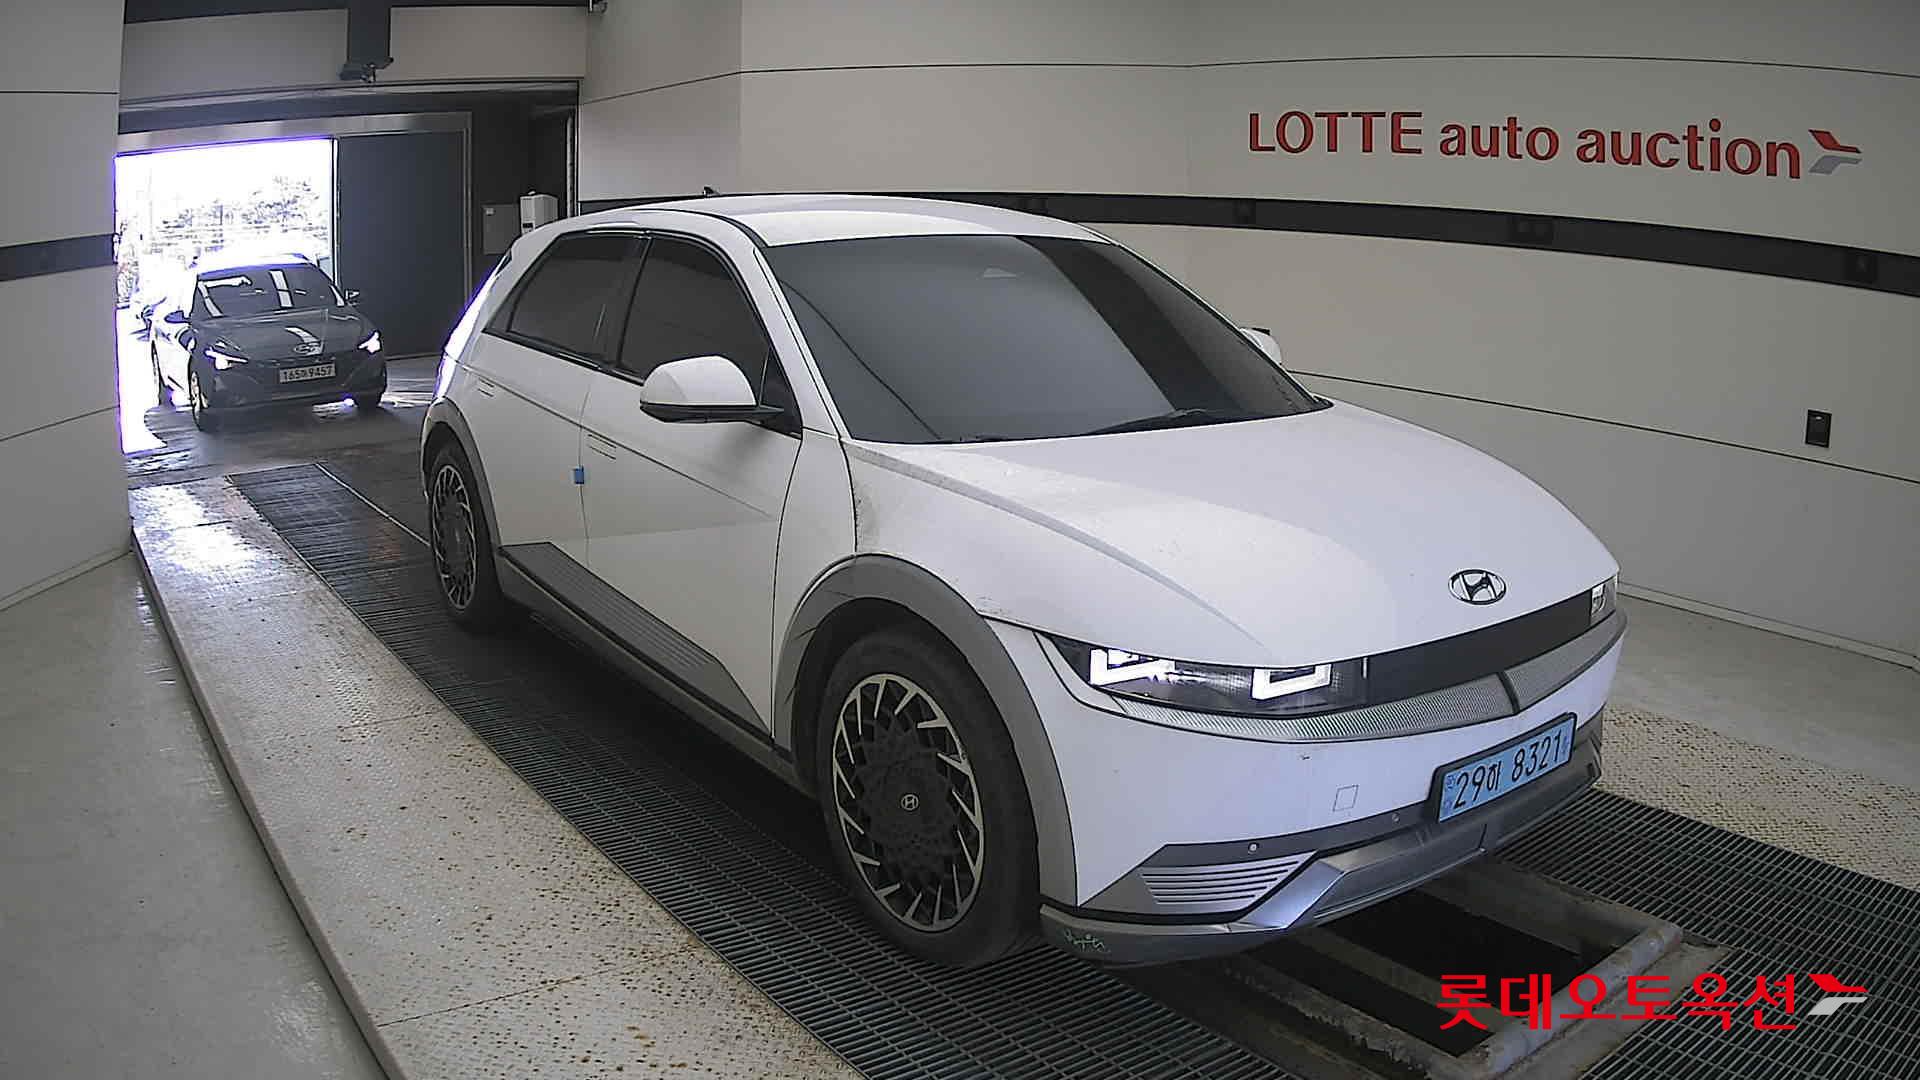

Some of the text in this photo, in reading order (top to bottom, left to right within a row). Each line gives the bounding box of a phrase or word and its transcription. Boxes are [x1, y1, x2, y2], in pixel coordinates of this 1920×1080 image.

[1248, 110, 1801, 179] LOTTE auto auction
[1512, 729, 1562, 783] 8321
